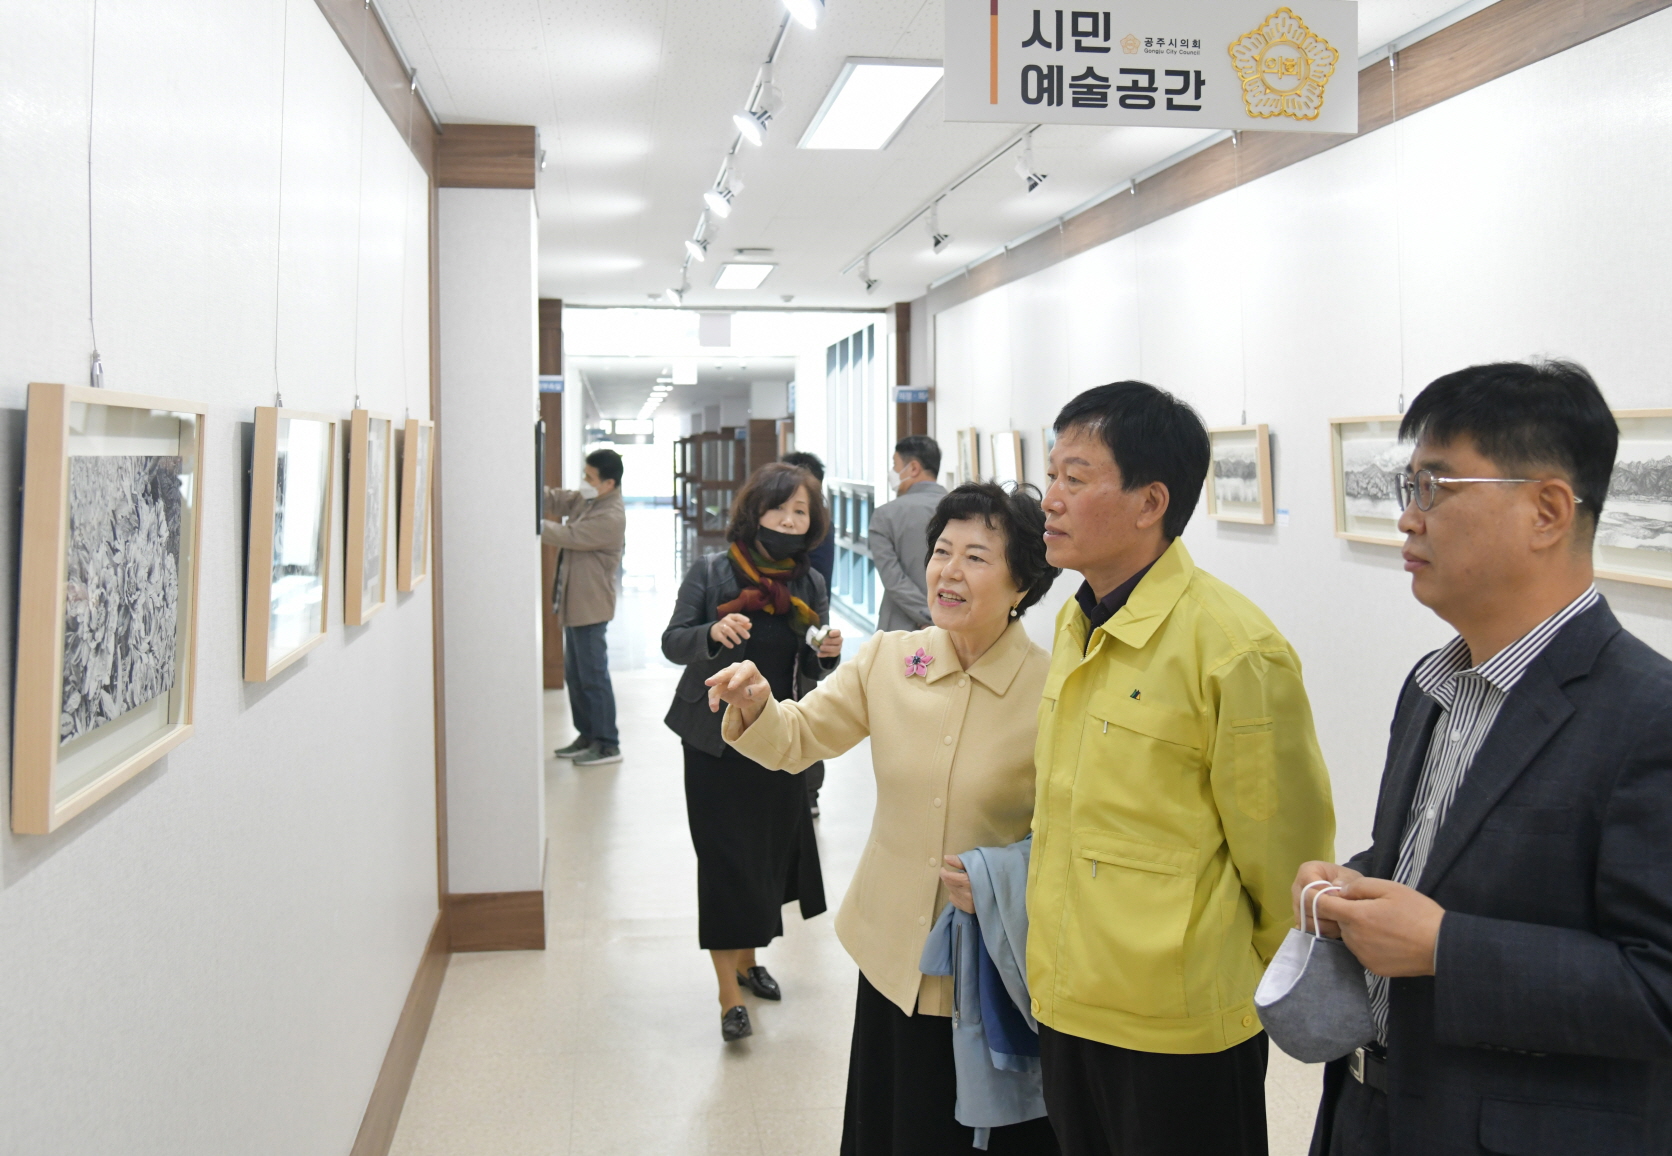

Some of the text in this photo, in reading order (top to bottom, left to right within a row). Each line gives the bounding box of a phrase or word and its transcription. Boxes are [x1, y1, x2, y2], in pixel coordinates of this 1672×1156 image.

[1022, 10, 1111, 53] 시민
[1144, 37, 1201, 49] 공주시의회
[1021, 64, 1206, 111] 예술공간
